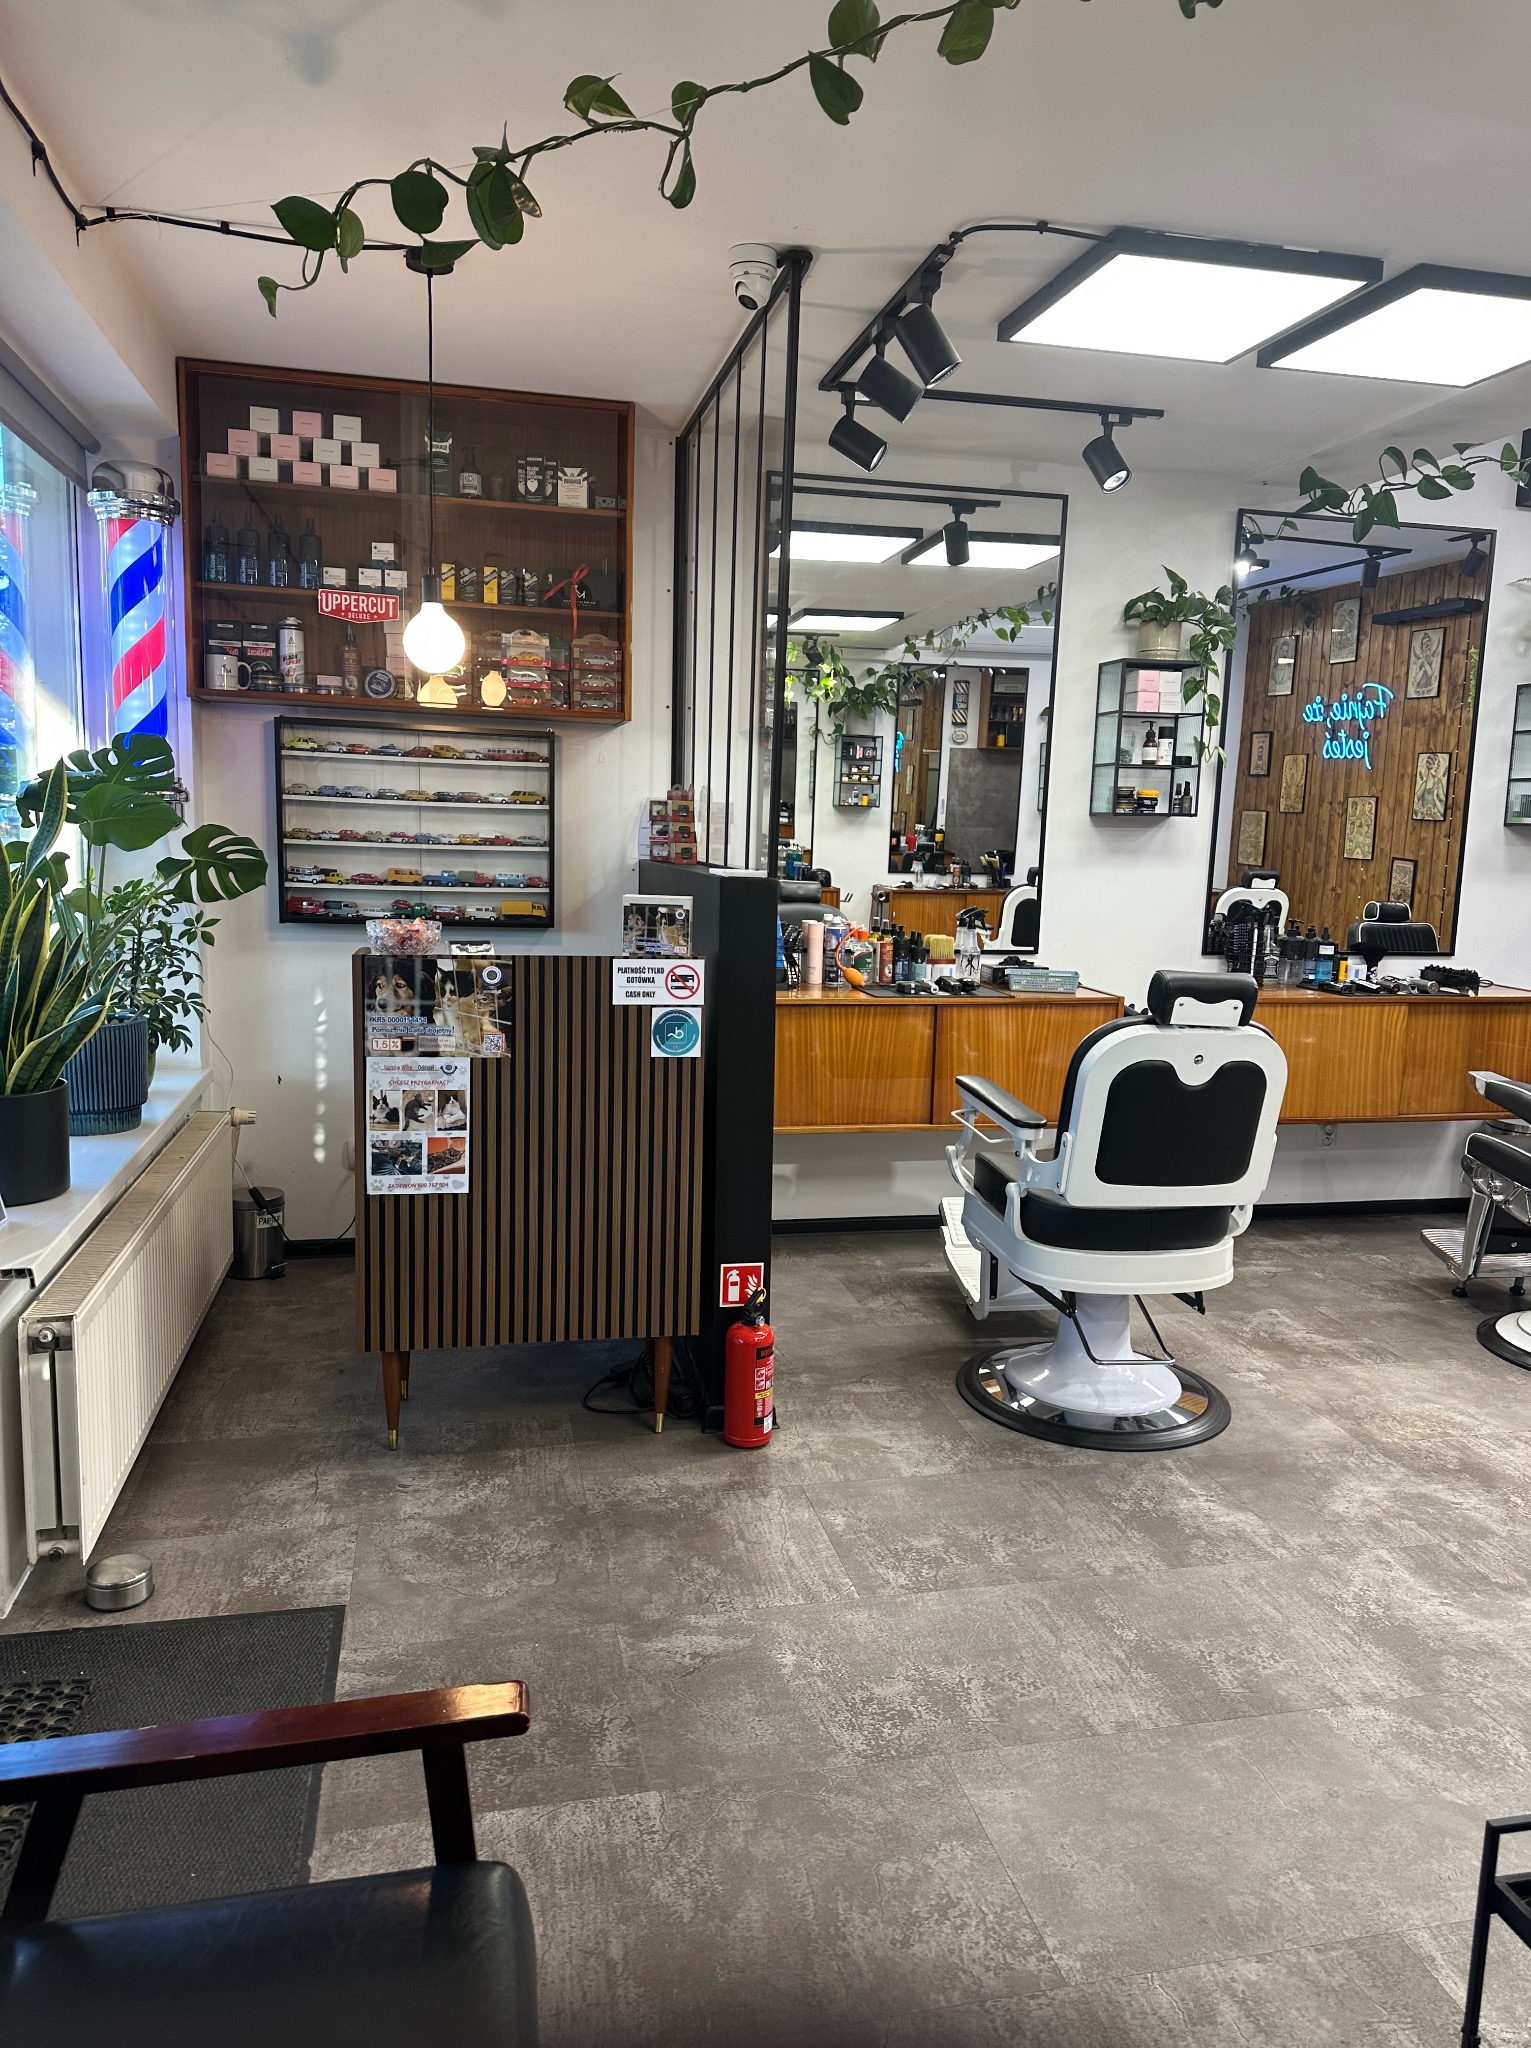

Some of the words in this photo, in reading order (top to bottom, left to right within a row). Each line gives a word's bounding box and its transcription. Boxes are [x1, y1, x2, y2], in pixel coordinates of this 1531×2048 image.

[321, 592, 396, 618] UPPERCUT
[617, 966, 646, 975] PŁATNOŚĆ
[647, 967, 665, 975] TYLKO
[626, 975, 656, 985] GOTÓWKĄ
[374, 1040, 389, 1050] 1,5
[391, 1040, 400, 1049] %
